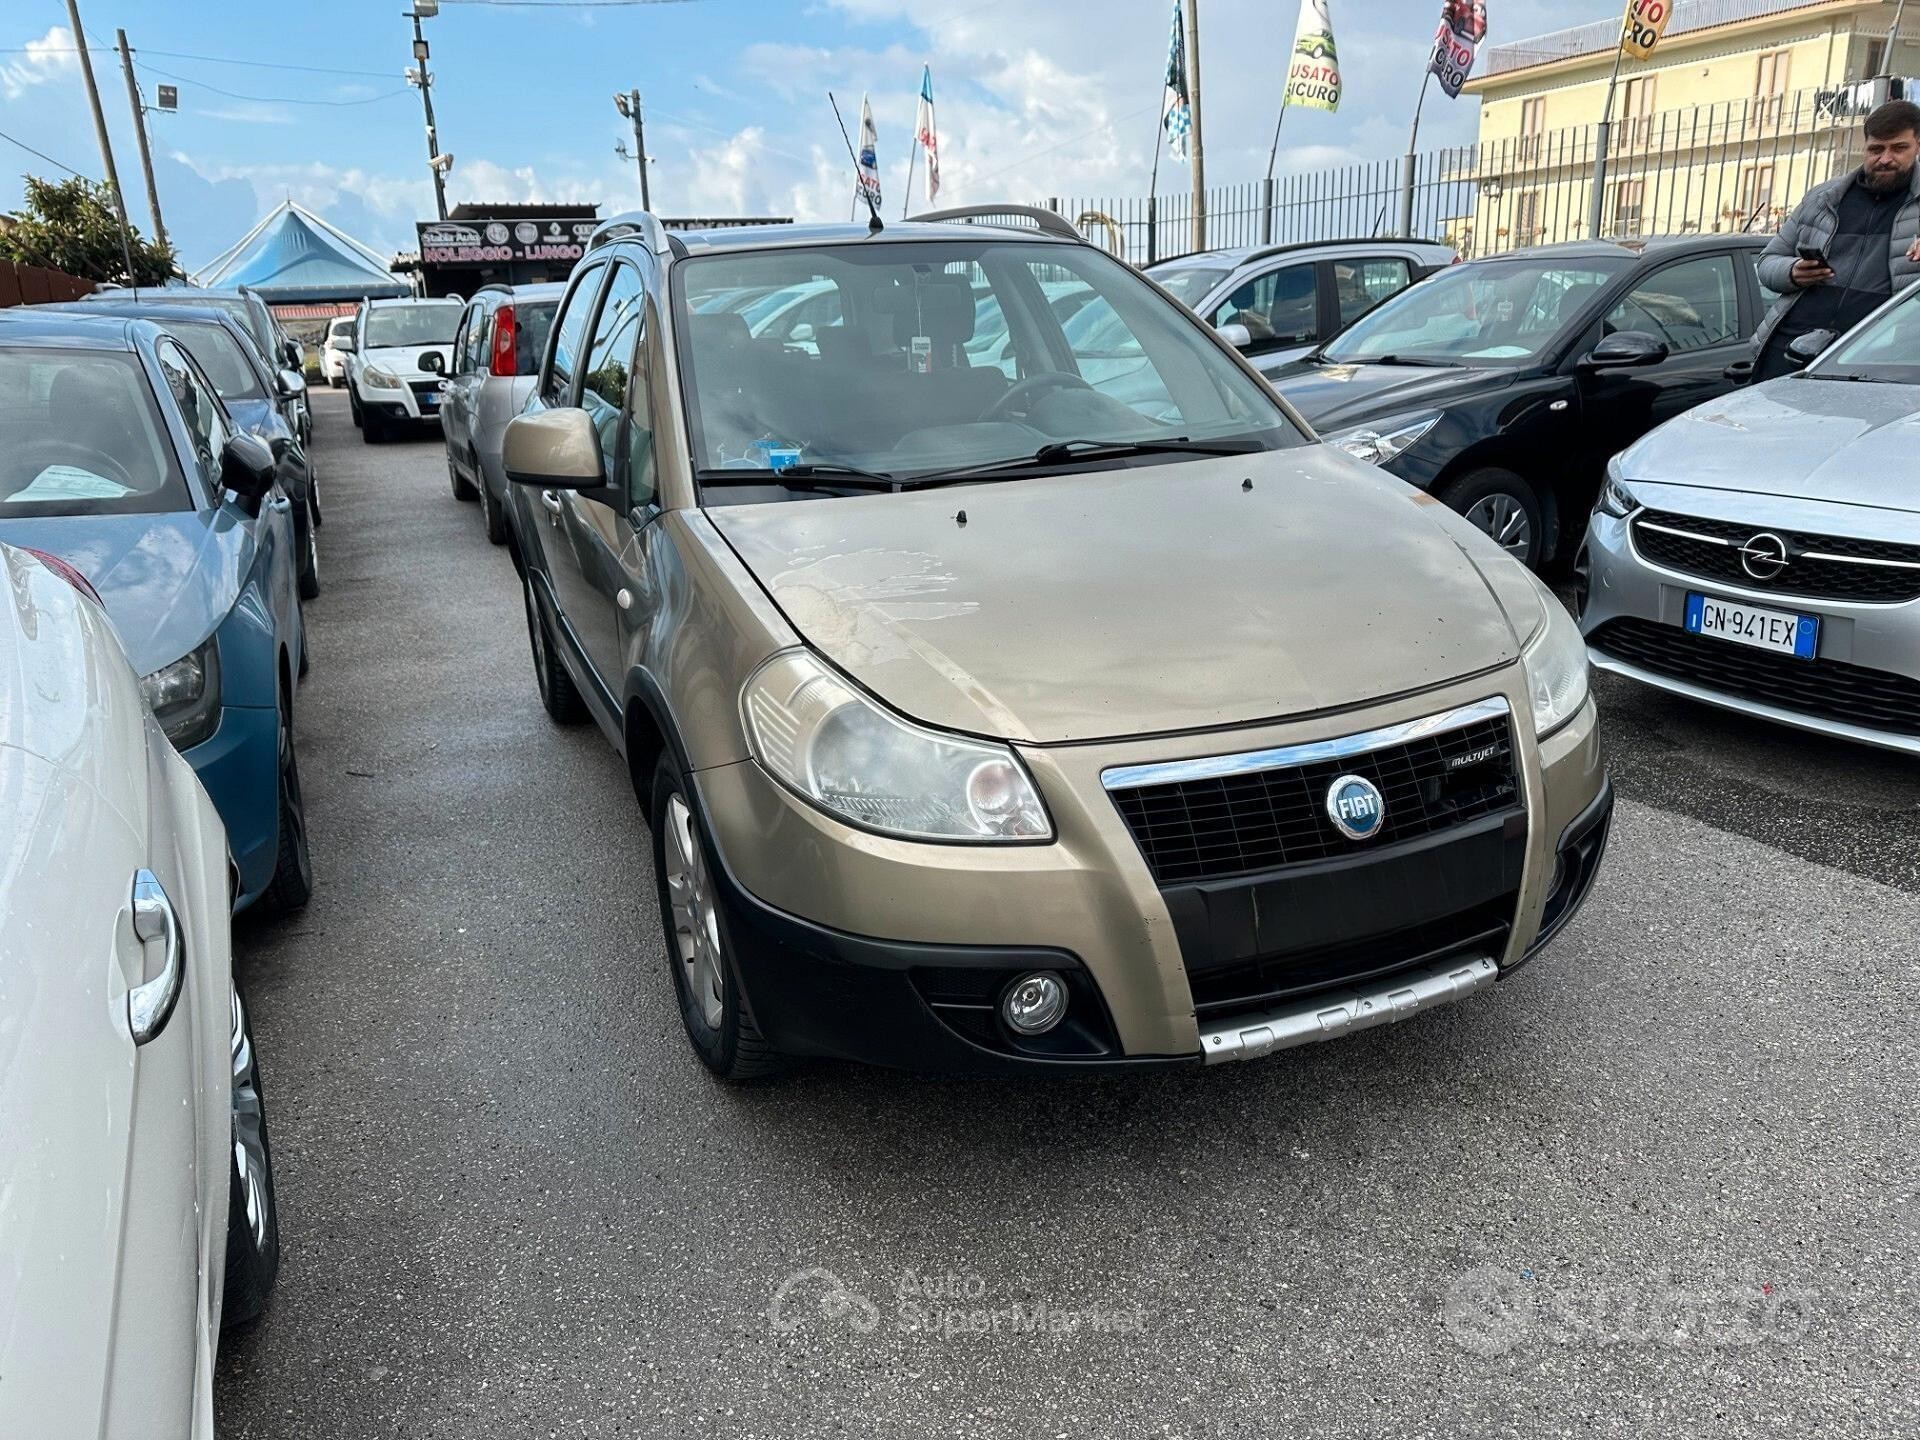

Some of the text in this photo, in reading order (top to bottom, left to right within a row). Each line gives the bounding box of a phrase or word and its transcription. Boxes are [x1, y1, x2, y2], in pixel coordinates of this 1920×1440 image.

[1291, 64, 1339, 86] USATO
[424, 246, 513, 263] NOLEGGIO
[525, 244, 583, 260] LUNGO
[1337, 793, 1377, 820] FIAT
